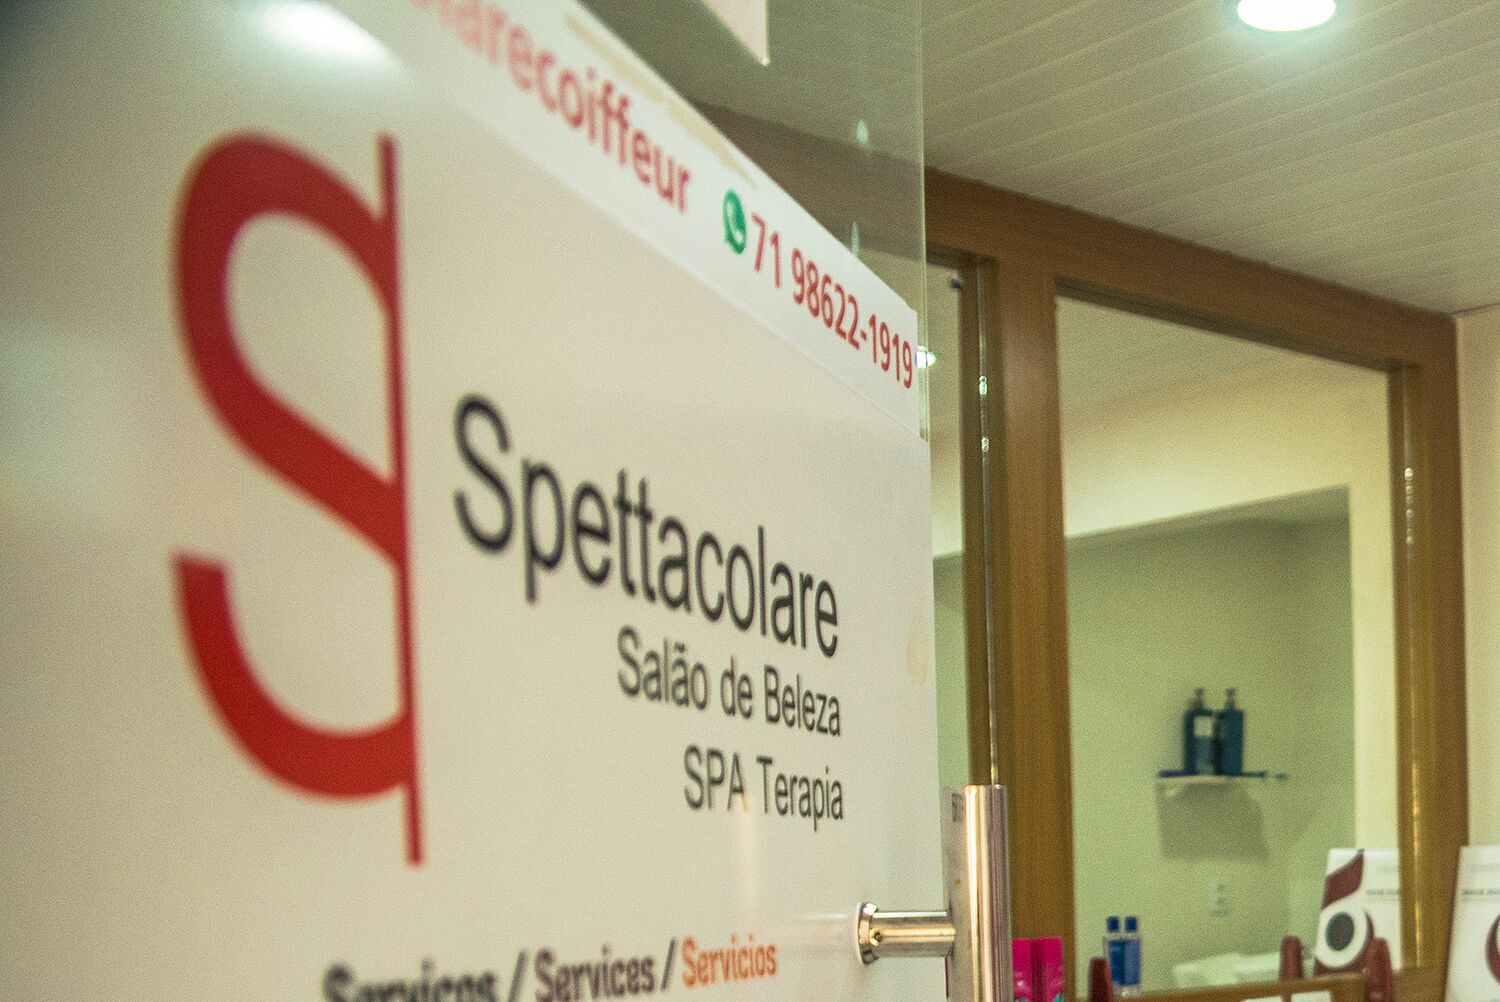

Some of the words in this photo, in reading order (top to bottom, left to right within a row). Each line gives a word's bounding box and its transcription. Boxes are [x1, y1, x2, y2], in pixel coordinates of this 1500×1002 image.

[751, 212, 783, 289] 71
[791, 246, 914, 390] 98622-1919
[453, 394, 839, 658] Spettacolare
[617, 626, 711, 711] Salão
[720, 656, 753, 720] de
[764, 665, 841, 737] Beleza
[684, 744, 747, 812] SPA
[756, 755, 844, 832] Terapia
[681, 934, 778, 988] Servicios
